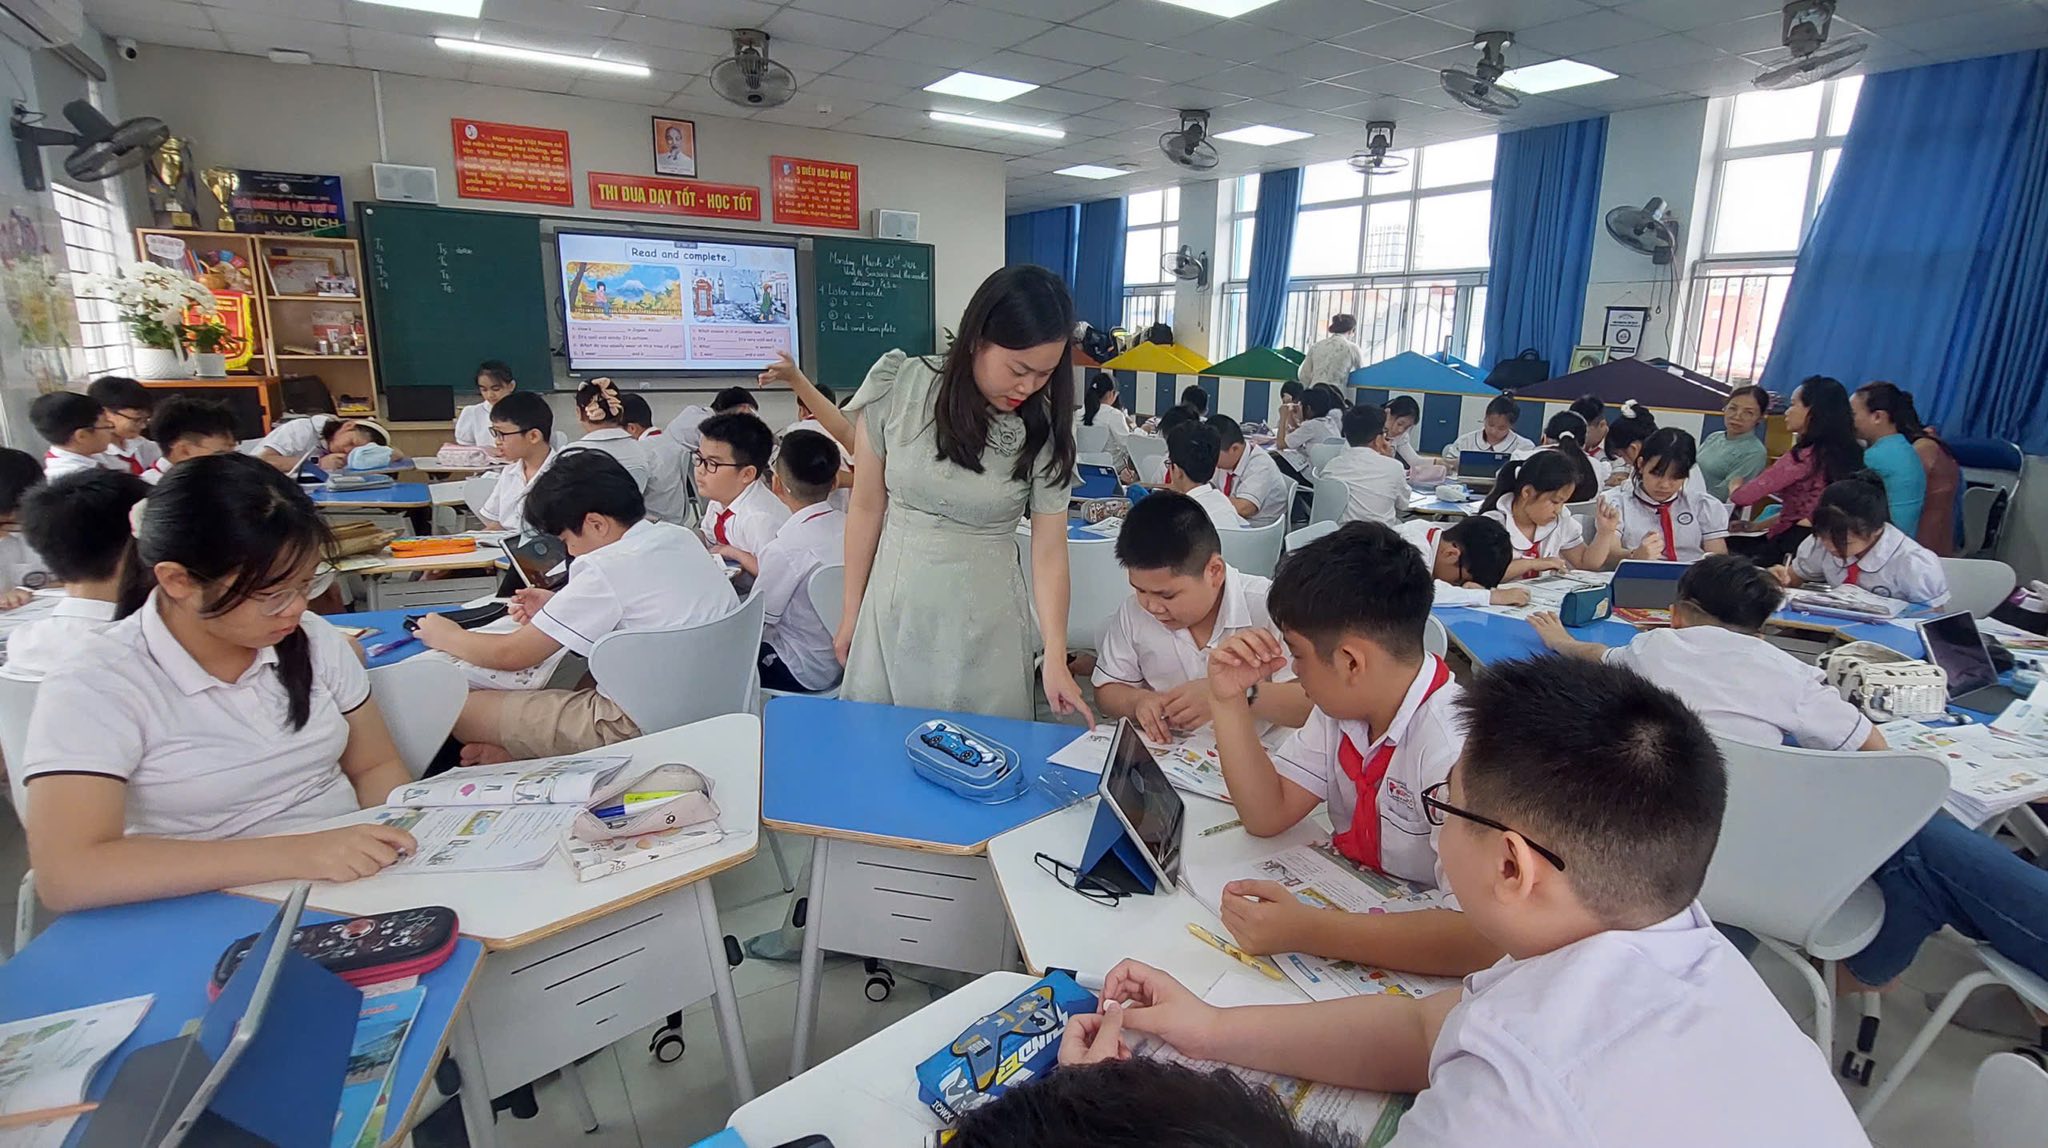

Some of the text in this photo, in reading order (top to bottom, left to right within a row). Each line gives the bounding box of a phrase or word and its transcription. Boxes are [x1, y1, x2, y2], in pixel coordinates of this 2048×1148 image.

[797, 166, 801, 175] 5
[598, 184, 617, 201] THI
[622, 186, 646, 202] ĐUA
[649, 188, 671, 208] DẠY
[675, 186, 696, 207] TỐT
[707, 193, 730, 212] HỌC
[733, 191, 752, 211] TỐT
[273, 215, 297, 226] VÔ
[301, 218, 338, 228] ĐỊCH
[631, 247, 730, 262] Read and complete.
